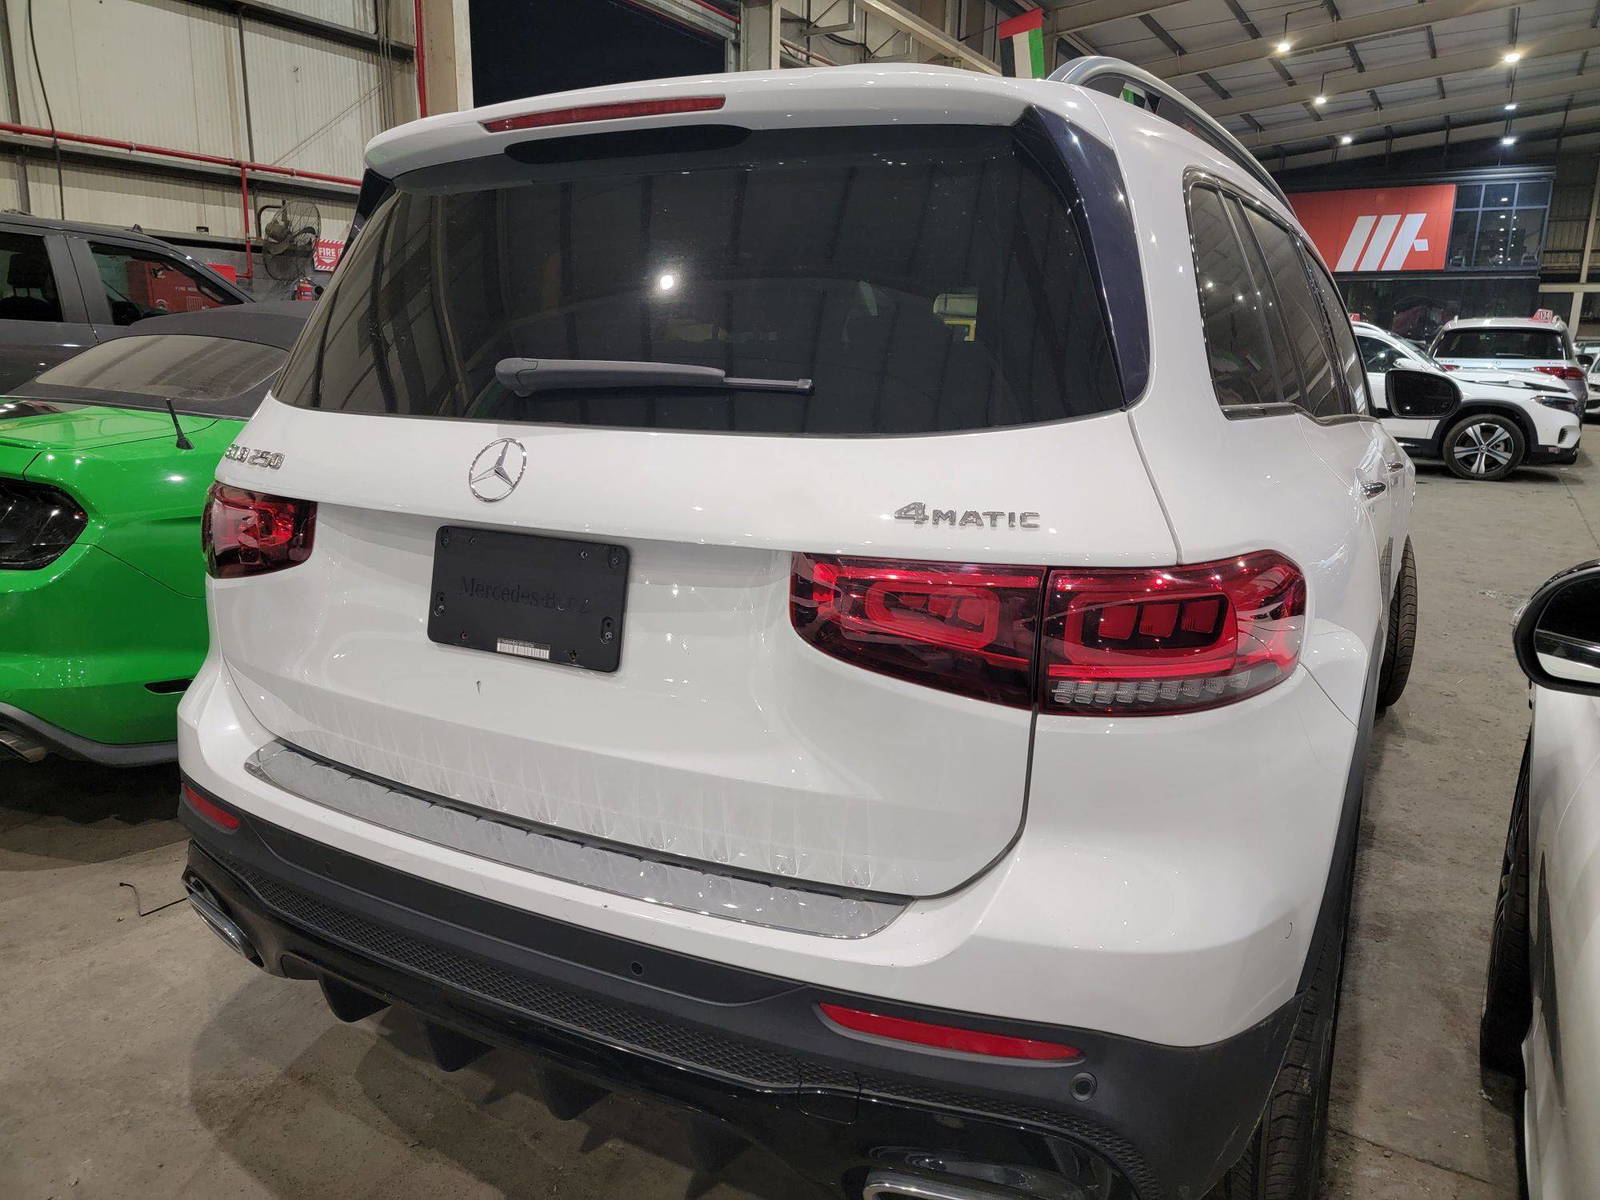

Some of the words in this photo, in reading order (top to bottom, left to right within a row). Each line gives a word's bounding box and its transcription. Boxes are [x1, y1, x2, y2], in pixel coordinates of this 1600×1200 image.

[318, 247, 337, 257] FIRE
[247, 449, 285, 470] 250
[894, 501, 1041, 528] 4MATIC
